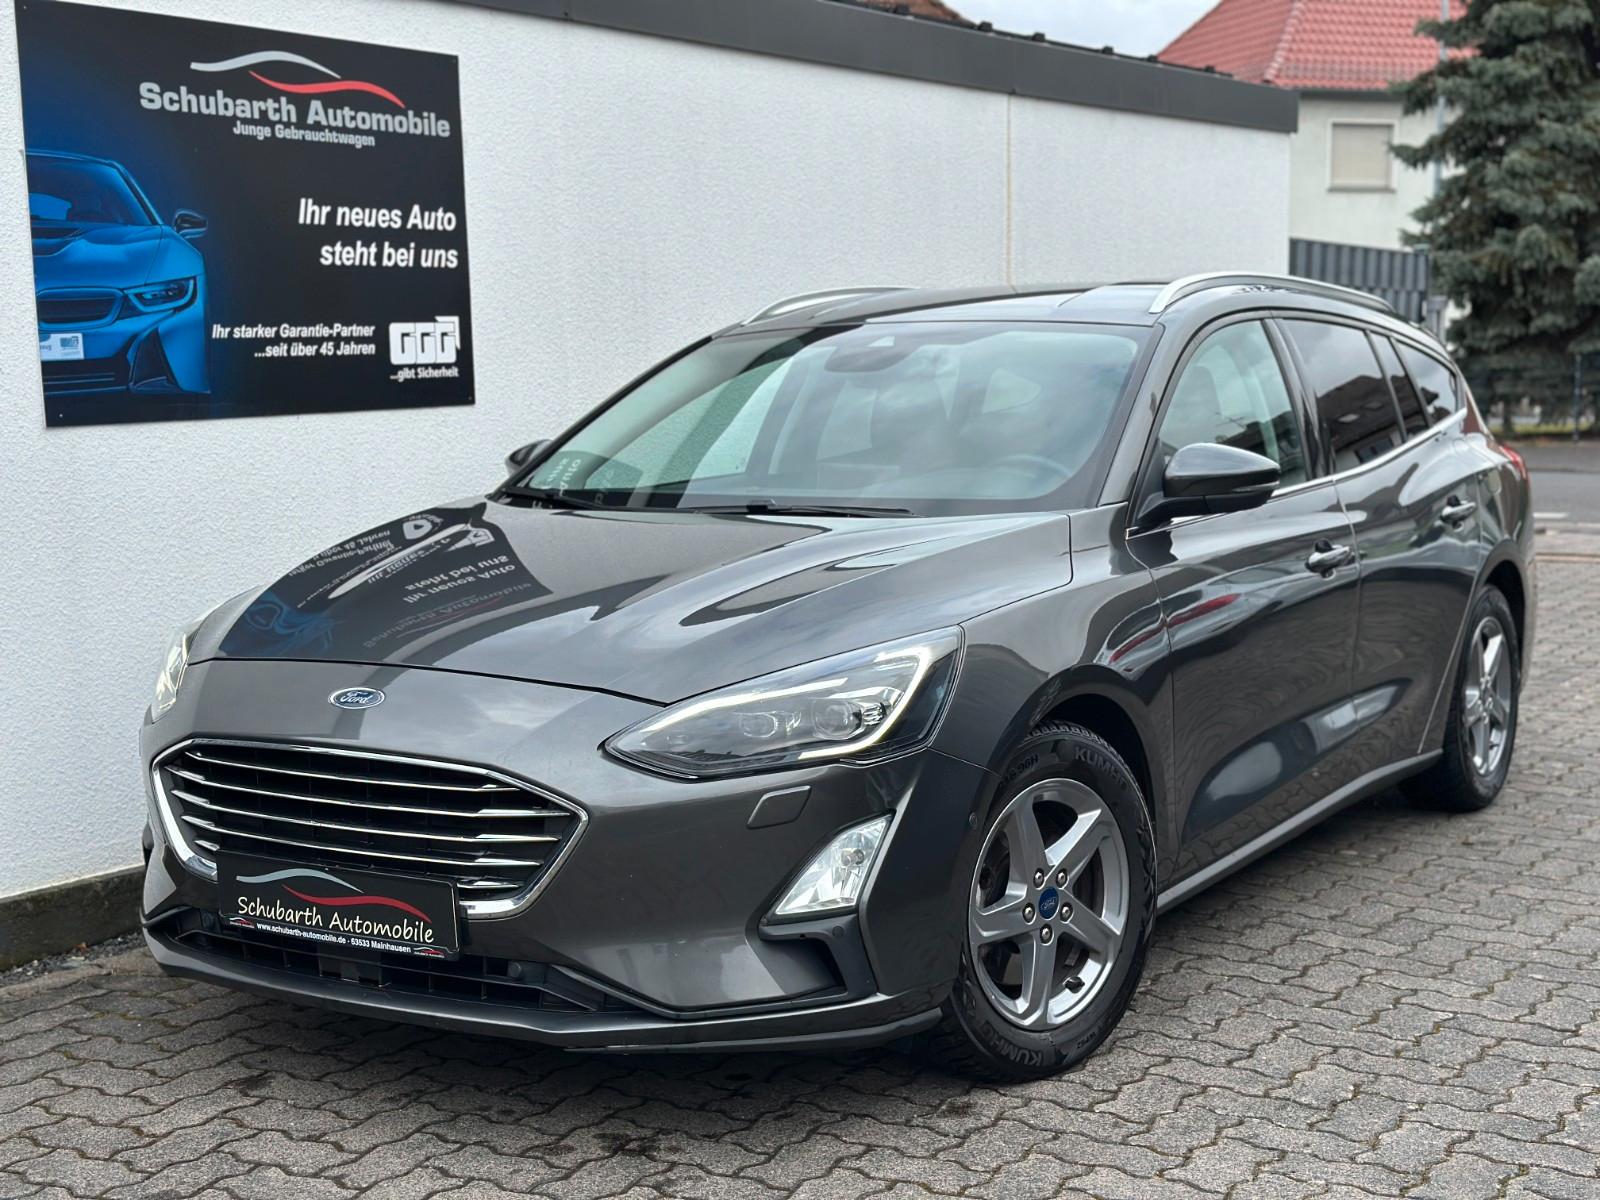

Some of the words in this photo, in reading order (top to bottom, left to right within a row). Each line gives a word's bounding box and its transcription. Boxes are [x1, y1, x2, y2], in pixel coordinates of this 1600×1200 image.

[139, 82, 297, 123] Schubarth
[306, 100, 451, 137] Automobile
[233, 120, 272, 140] Junge
[275, 124, 375, 148] Gebrauchtwagen
[299, 198, 331, 225] Ihr
[336, 206, 402, 229] neues
[407, 204, 456, 231] Auto
[320, 241, 377, 267] steht
[382, 242, 415, 267] bei
[420, 247, 458, 268] uns
[212, 324, 229, 338] Ihr
[233, 324, 277, 339] starker
[280, 324, 375, 338] Garantie-Partner
[255, 343, 287, 357] ...seit
[290, 342, 316, 357] über
[320, 342, 334, 356] 45
[336, 342, 375, 356] Jahren
[417, 366, 459, 379] Sicherheit
[339, 691, 374, 704] Ford
[237, 896, 323, 927] Schubarth
[329, 911, 434, 943] Automobile
[256, 922, 346, 944] www.schubarth-automobile.de
[371, 941, 411, 953] Mainhausen
